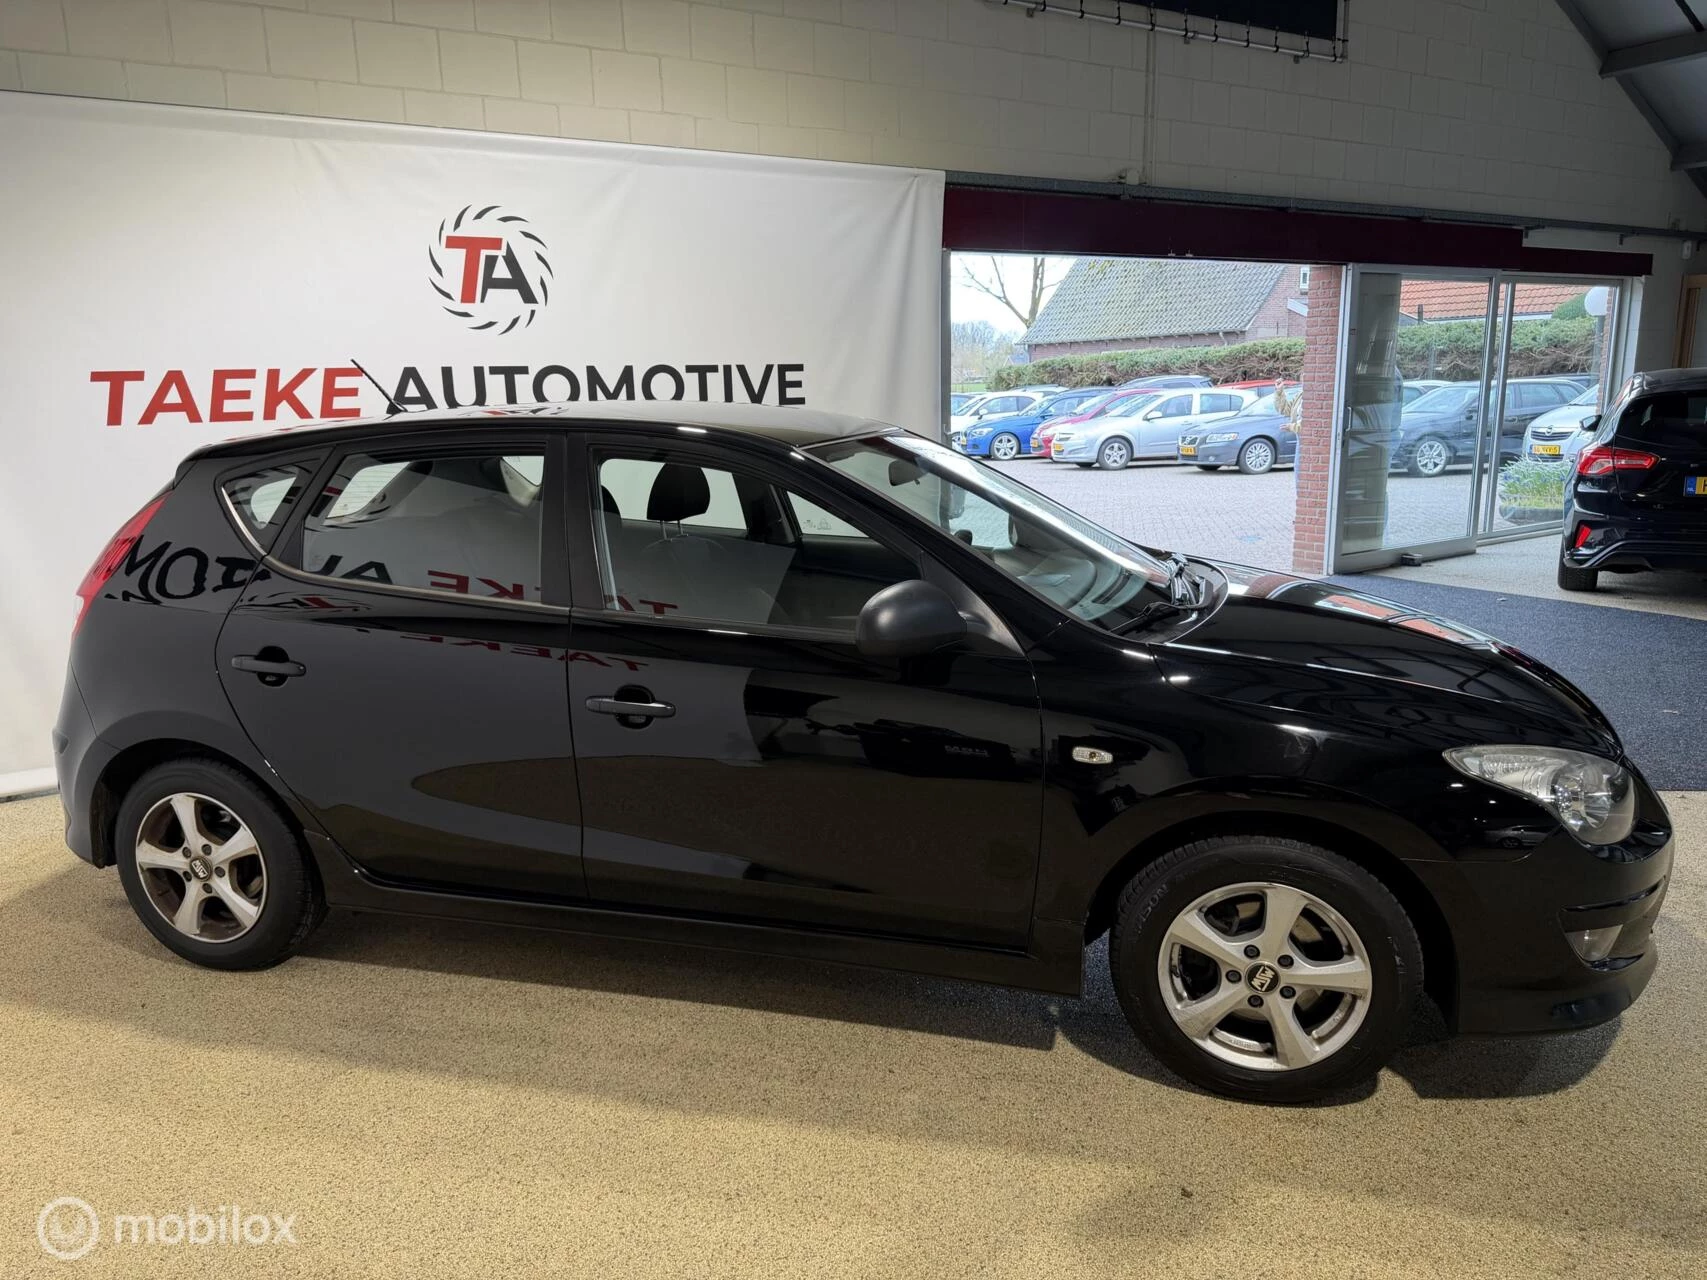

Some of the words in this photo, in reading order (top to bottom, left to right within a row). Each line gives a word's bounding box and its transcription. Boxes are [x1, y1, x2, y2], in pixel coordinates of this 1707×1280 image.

[445, 235, 539, 304] TA
[90, 367, 364, 426] TAEKE
[386, 363, 806, 415] AUTOMOTIVE
